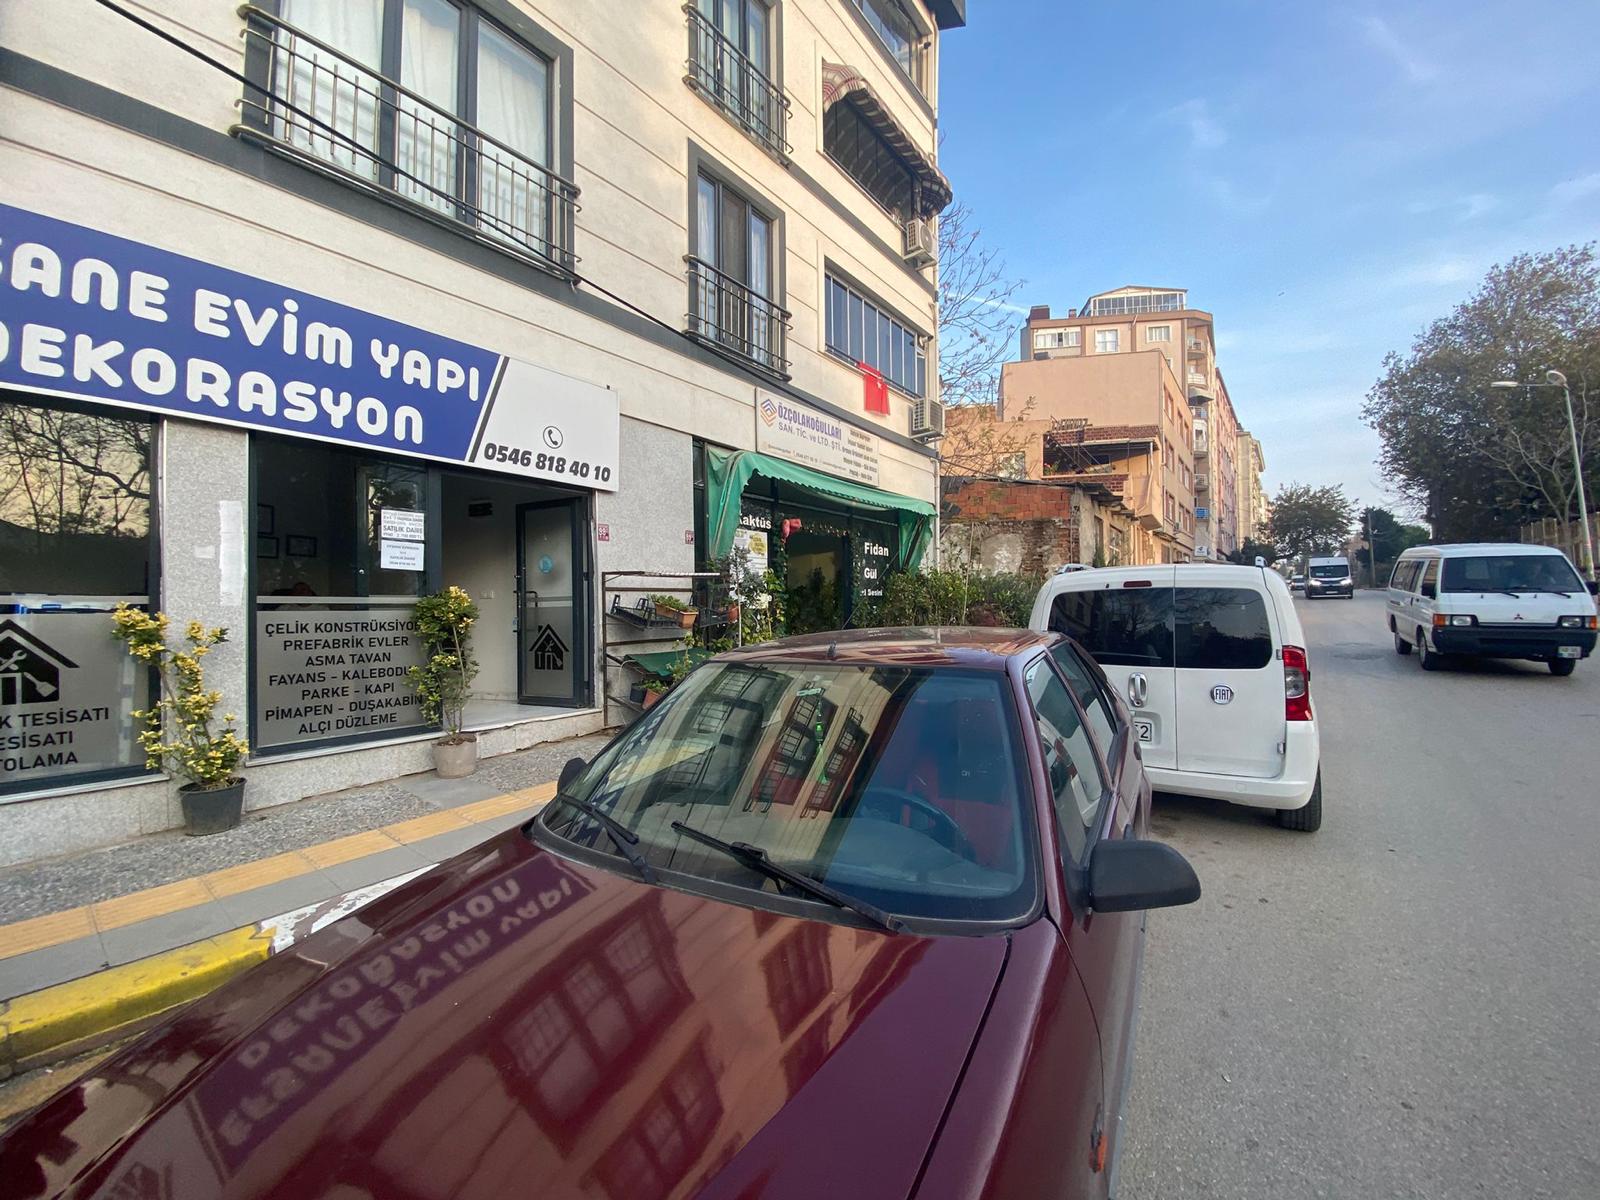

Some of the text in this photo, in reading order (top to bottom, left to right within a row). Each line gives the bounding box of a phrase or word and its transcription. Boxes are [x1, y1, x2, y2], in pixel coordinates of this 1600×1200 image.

[0, 236, 170, 323] ANE
[370, 339, 479, 402] YAPI
[0, 320, 423, 445] EKORASYON
[777, 402, 842, 440] ÖZÇOLAKOĞULLARI
[484, 443, 611, 482] 0546 818 40 10
[864, 542, 889, 557] Fidan
[864, 567, 877, 580] Gül
[266, 621, 310, 637] ÇELİK
[284, 636, 409, 651] PREFABRİK EVLER
[306, 653, 391, 667] ASMA TAVAN
[270, 672, 325, 686] FAYANS
[302, 686, 349, 700] PARKE
[365, 683, 394, 694] KAPI
[1216, 688, 1230, 700] FIAT
[18, 707, 109, 727] TESİSATI
[266, 704, 333, 721] PİMAPEN
[299, 713, 397, 735] ALÇI DÜZLEME
[1135, 724, 1148, 738] 2
[0, 752, 78, 771] OLAMA
